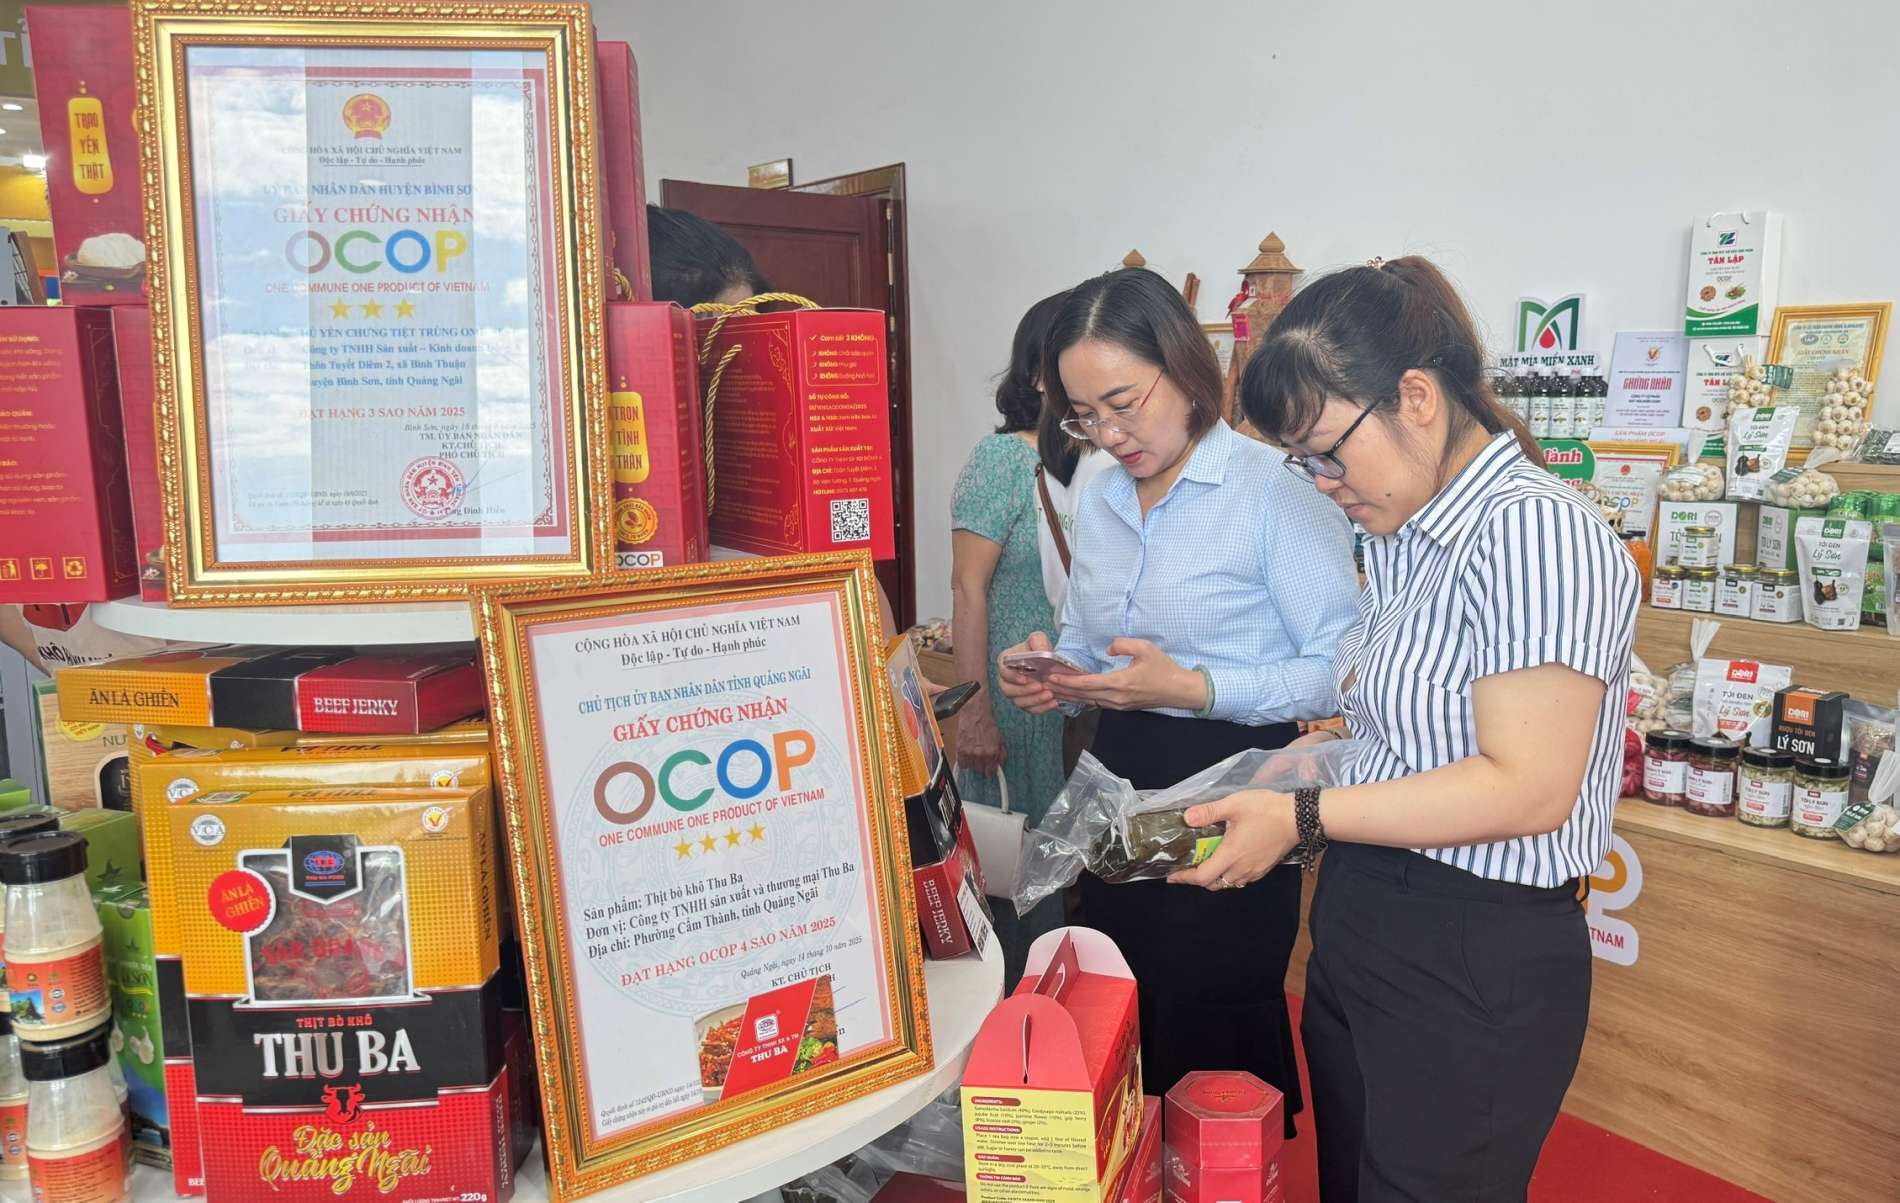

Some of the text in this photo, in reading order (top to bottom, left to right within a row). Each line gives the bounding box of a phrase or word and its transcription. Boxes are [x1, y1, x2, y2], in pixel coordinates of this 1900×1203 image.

[441, 146, 461, 154] NAM
[312, 182, 454, 198] NHÂN DÂN HUYỆN BÌNH
[334, 203, 411, 223] CHỨNG
[416, 204, 474, 226] NHẬN
[285, 229, 468, 274] OCOP
[1727, 254, 1745, 266] LẬP
[352, 283, 375, 293] ONE
[428, 282, 442, 293] OF
[1567, 355, 1595, 366] XANH
[328, 406, 465, 421] HẠNG 3 SAO NĂM 2025
[616, 430, 640, 445] TÌNH
[1671, 511, 1697, 520] DORI
[575, 614, 800, 654] CỘNG HÒA XÃ HỘI CHỦ NGHĨA VIỆT NAM
[621, 637, 767, 667] Độc lập Tự do Hạnh phúc
[578, 666, 811, 714] CHỦ TỊCH ỦY BAN NHÂN DÂN TỈNH QUẢNG NGÃI
[313, 697, 399, 716] BEEF JERKY
[613, 696, 788, 742] GIẤY CHỨNG NHẬN
[1777, 734, 1816, 755] LÝ SƠN
[593, 729, 817, 825] OCOP
[192, 824, 225, 835] VCA
[599, 787, 825, 848] ONE COMMUNE ONE PRODUCT OF VIETNAM
[583, 872, 743, 923] Sản phẩm: Thịt bò khô Thu Ba
[586, 862, 855, 941] Đơn vị: Công ty TNHH sản xuất và thương mại Thu Ba
[588, 887, 819, 960] Địa chỉ: Phường Cẩm Thành, tỉnh Quảng Ngãi
[922, 879, 953, 944] BEEF JERKY
[620, 916, 836, 988] ĐẠT HẠNG OCOP 4 SAO NĂM 2025
[740, 968, 761, 980] Quảng
[798, 953, 805, 962] 14
[807, 949, 824, 960] tháng
[834, 942, 847, 951] năm
[848, 936, 863, 946] 2025
[771, 963, 832, 987] KT. CHỦ TỊCH
[296, 1013, 373, 1030] THỊT BÒ KHÔ
[253, 1028, 421, 1078] THU BA
[751, 1046, 788, 1063] THU BA
[293, 1120, 392, 1158] Đặc sản
[259, 1144, 432, 1195] Quảng Ngãi
[460, 1192, 488, 1203] 220g
